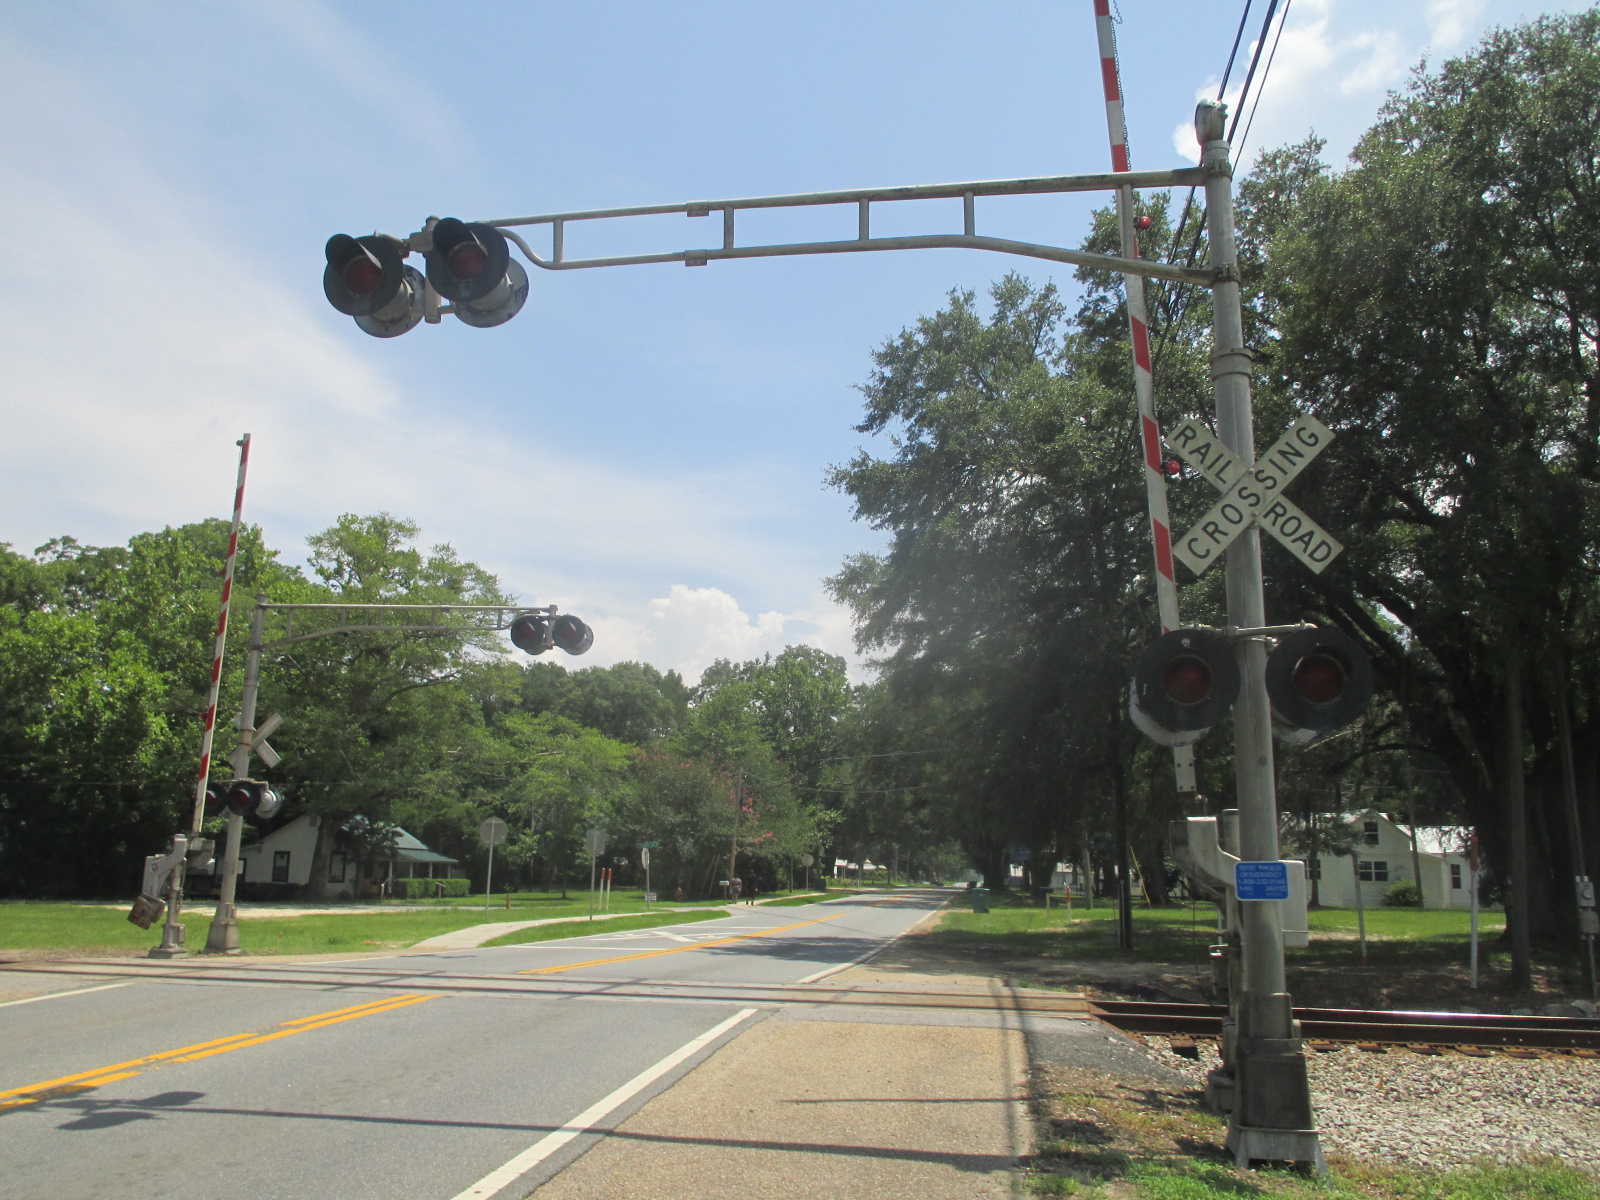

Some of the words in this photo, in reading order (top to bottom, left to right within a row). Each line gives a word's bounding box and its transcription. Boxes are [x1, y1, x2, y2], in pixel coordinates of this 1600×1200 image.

[1173, 425, 1232, 484] RAIL
[1263, 501, 1331, 562] ROAD
[1187, 426, 1319, 560] CROSSING
